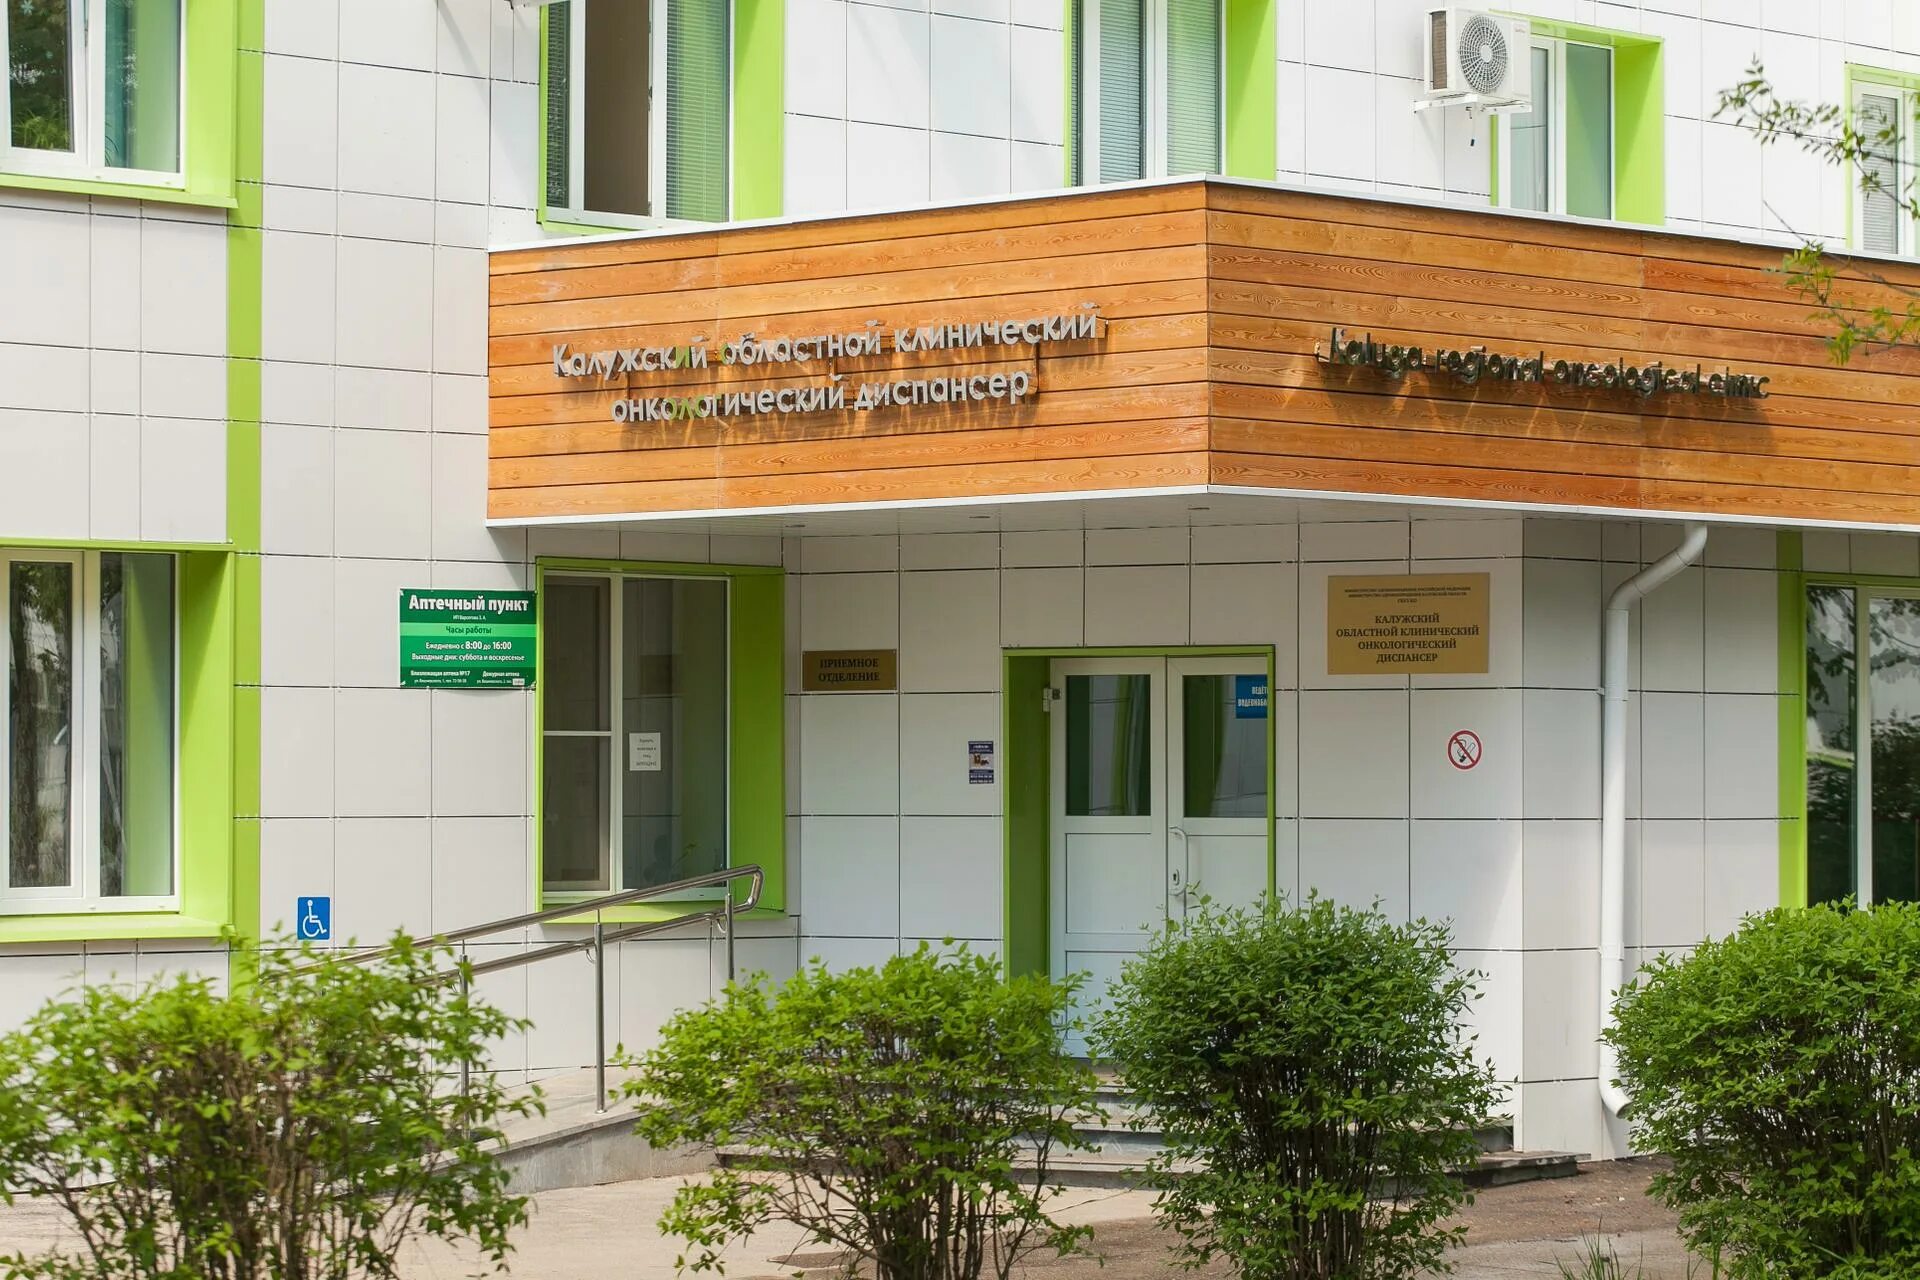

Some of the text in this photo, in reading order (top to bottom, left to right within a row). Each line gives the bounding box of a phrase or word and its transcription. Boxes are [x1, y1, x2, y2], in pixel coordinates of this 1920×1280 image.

[553, 303, 1097, 380] Калужский областной клинический
[611, 370, 1029, 423] онкологический диспансер
[408, 594, 529, 615] Аптечный пункт
[1375, 612, 1440, 624] КАЛУЖСКИЙ
[445, 625, 492, 635] Часы работы
[1336, 625, 1479, 637] ОБЛАСТНОЙ КЛИНИЧЕСКИЙ
[425, 642, 460, 650] Ежедневно
[465, 641, 482, 650] 8:00
[492, 641, 512, 650] 16:00
[1358, 638, 1457, 649] ОНКОЛОГИЧЕСКИЙ
[411, 653, 444, 661] Выходные
[459, 653, 482, 662] суббота
[820, 658, 879, 668] ПРИЕМНОЕ
[1376, 653, 1438, 664] ДИСПАНСЕР
[818, 672, 880, 682] ОТДЕЛЕНИЕ
